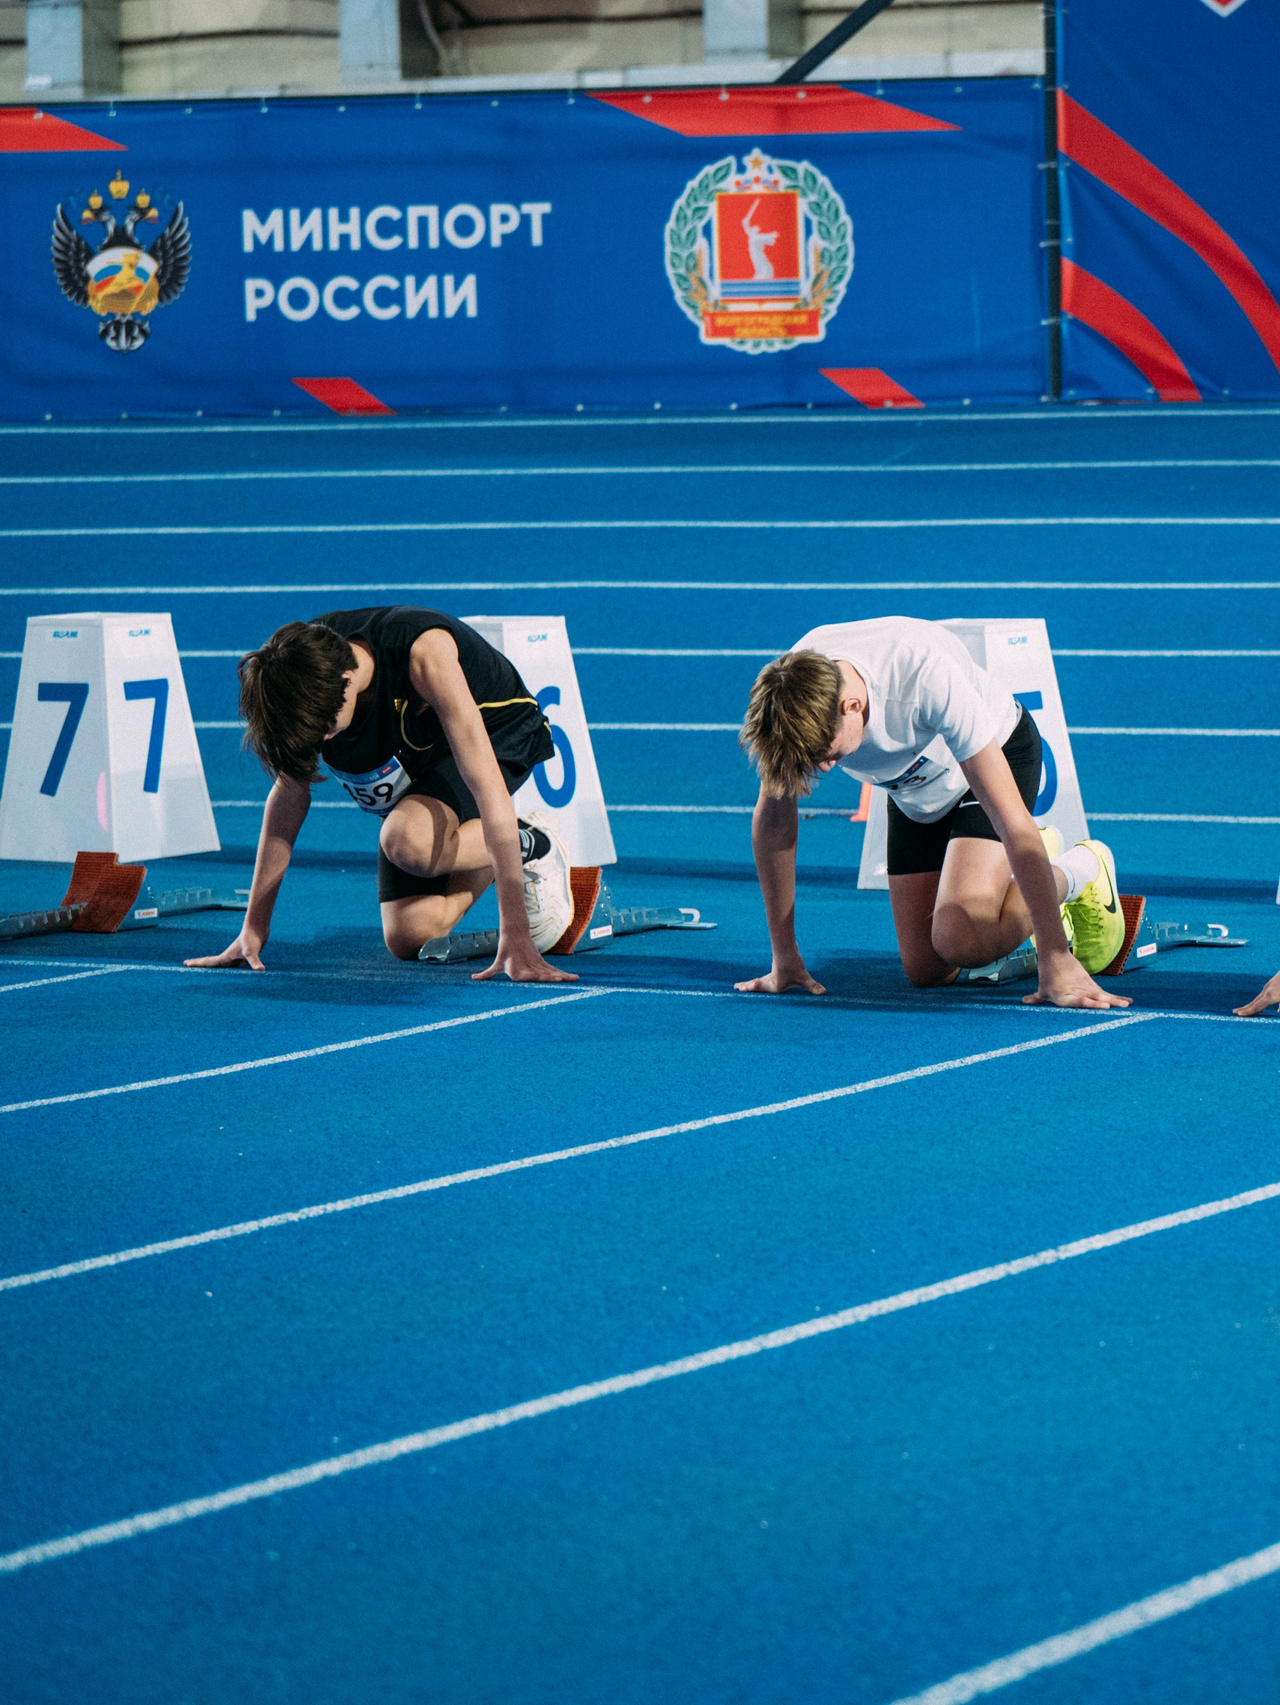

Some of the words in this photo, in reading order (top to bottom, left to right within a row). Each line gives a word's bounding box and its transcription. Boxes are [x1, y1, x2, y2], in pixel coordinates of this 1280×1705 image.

[243, 202, 551, 252] МИНСПОРТ
[245, 274, 477, 322] РОССИИ
[38, 682, 90, 798] 7
[123, 678, 169, 794] 7
[533, 686, 576, 809] 6
